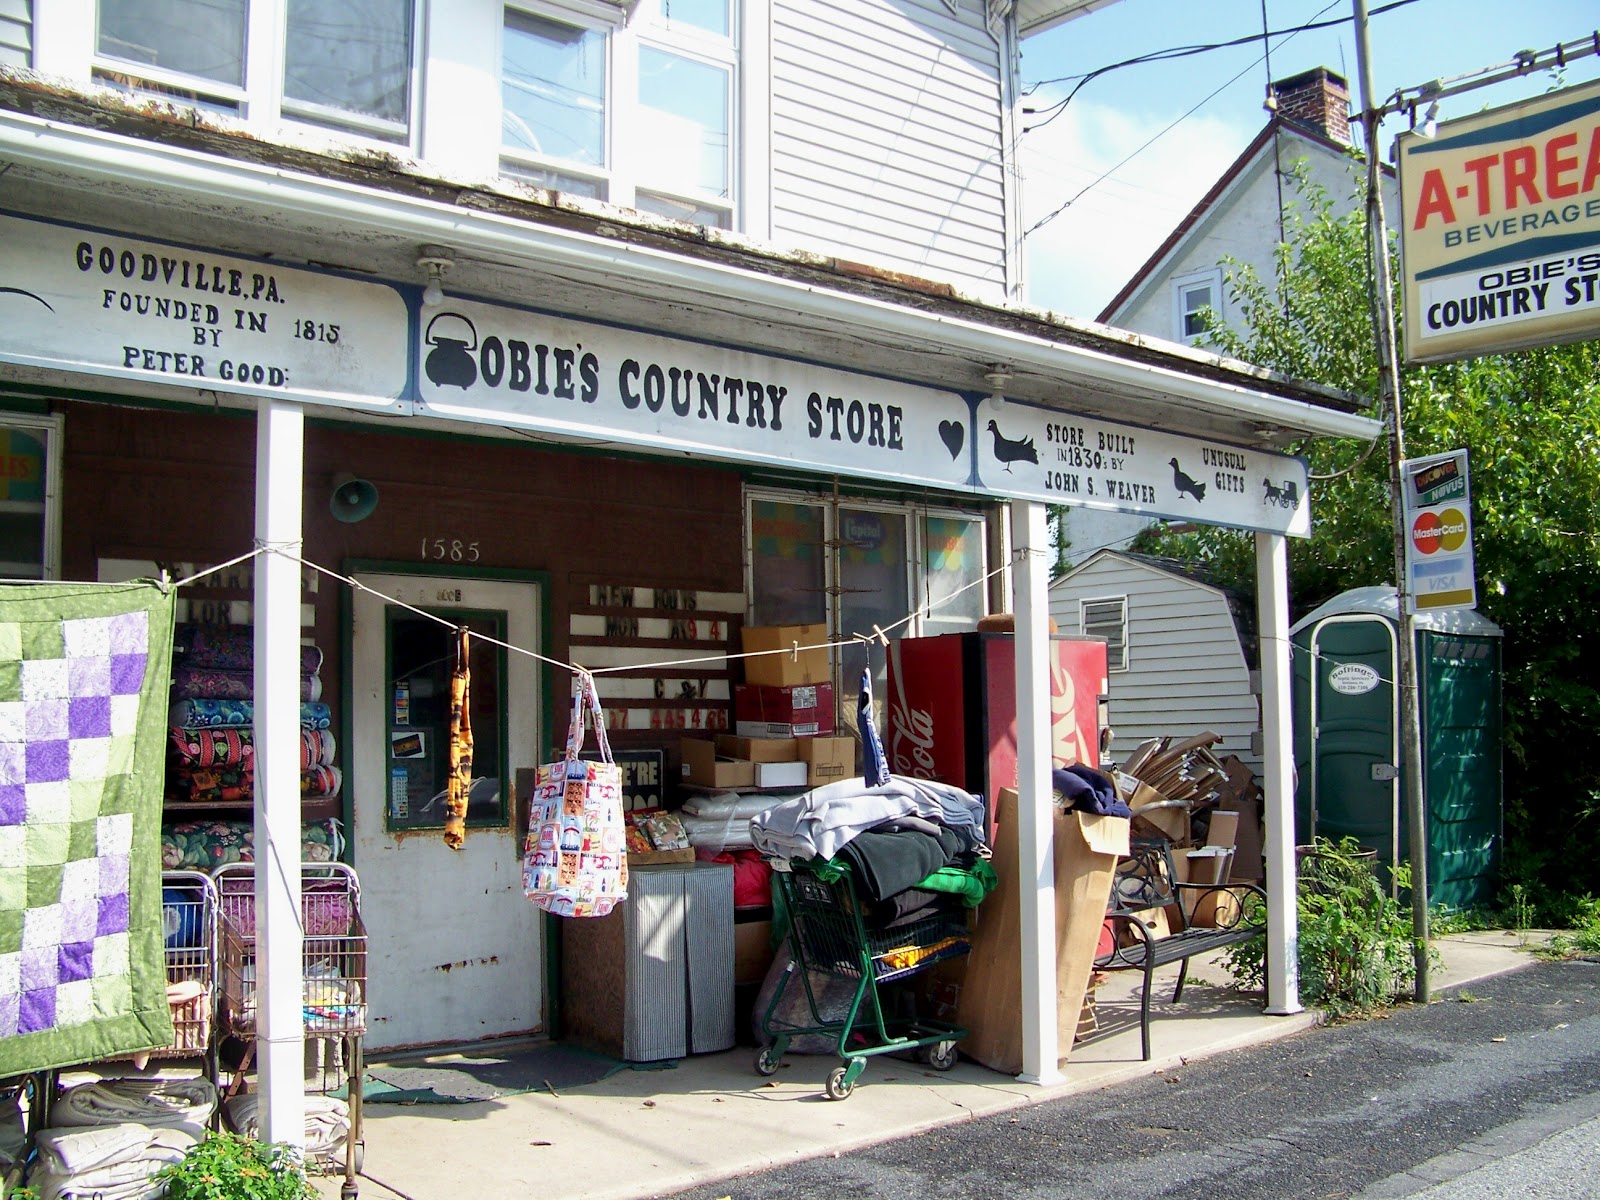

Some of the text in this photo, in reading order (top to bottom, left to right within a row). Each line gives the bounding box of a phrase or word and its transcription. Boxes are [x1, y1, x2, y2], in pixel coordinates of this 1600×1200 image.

[1427, 273, 1600, 330] COUNTRY ST
[102, 289, 341, 345] FOUNDED IN 1815
[193, 326, 223, 348] BY
[122, 346, 205, 377] PETER
[480, 335, 904, 451] OBIE'S COUNTRY STORE
[1046, 423, 1136, 456] STORE BUILT
[1057, 448, 1067, 462] IN
[1111, 457, 1125, 471] BY
[1202, 447, 1247, 472] UNUSUAL
[1045, 470, 1156, 504] JOHN S. WEAVER
[1215, 472, 1245, 494] GIFTS
[1431, 476, 1465, 501] NOVUS
[1413, 522, 1466, 540] MasterCard
[421, 537, 481, 563] 1585
[1428, 575, 1457, 591] VISA
[616, 761, 658, 786] E'RE
